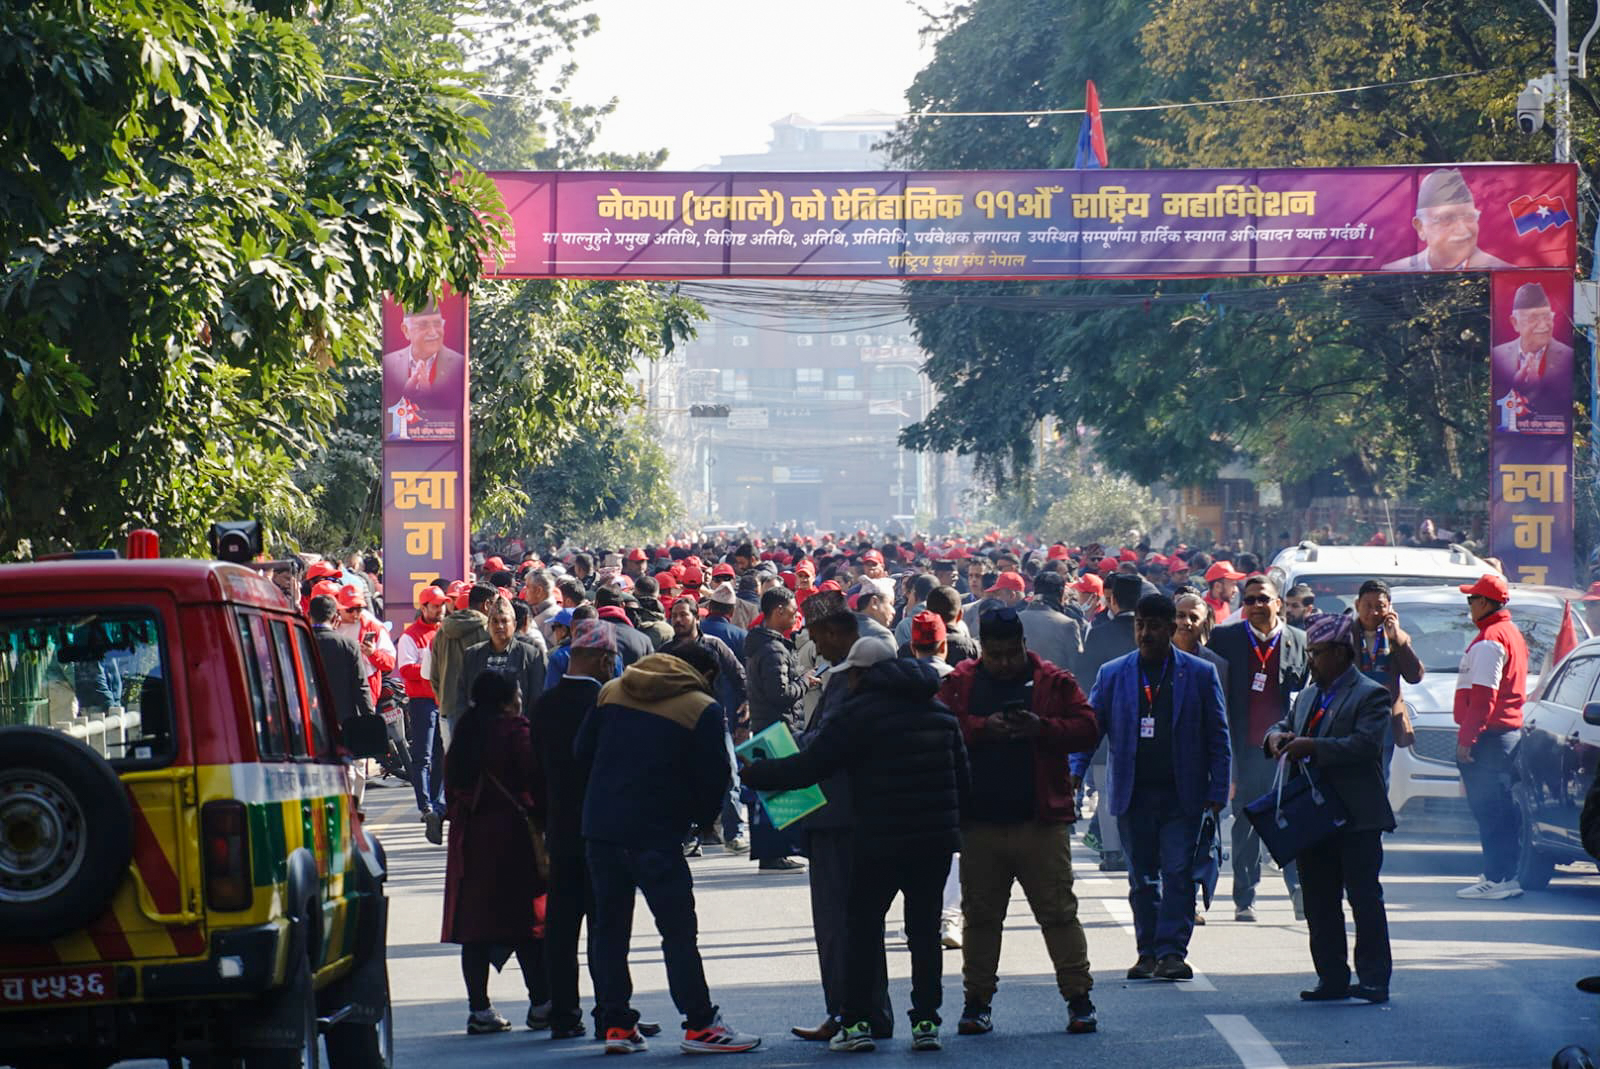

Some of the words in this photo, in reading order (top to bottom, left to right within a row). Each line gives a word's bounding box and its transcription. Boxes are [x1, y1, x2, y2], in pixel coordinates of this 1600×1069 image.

[597, 188, 676, 221] नेकपा
[682, 189, 785, 227] (एमाले)
[790, 188, 828, 221] को
[831, 187, 964, 221] ऐतिहासिक
[1071, 185, 1152, 224] राष्ट्रिय
[1161, 184, 1317, 218] महाधिवेशन
[542, 232, 559, 245] मा
[561, 227, 613, 252] पाल्नुहुने
[614, 232, 650, 251] प्रमुख
[653, 228, 701, 248] अतिथि,
[704, 228, 748, 246] विशिष्ट
[749, 228, 798, 248] अतिथि,
[801, 228, 849, 248] अतिथि,
[852, 227, 911, 247] प्रतिनिधि,
[913, 227, 970, 244] पर्यवेक्षक
[973, 231, 1021, 244] लगायत
[1027, 226, 1080, 243] उपस्थित
[1140, 225, 1182, 244] हार्दिक
[1184, 229, 1228, 242] स्वागत
[1229, 225, 1294, 242] अभिवादन
[1295, 228, 1328, 241] व्यक्त
[988, 250, 1027, 268] नेपाल
